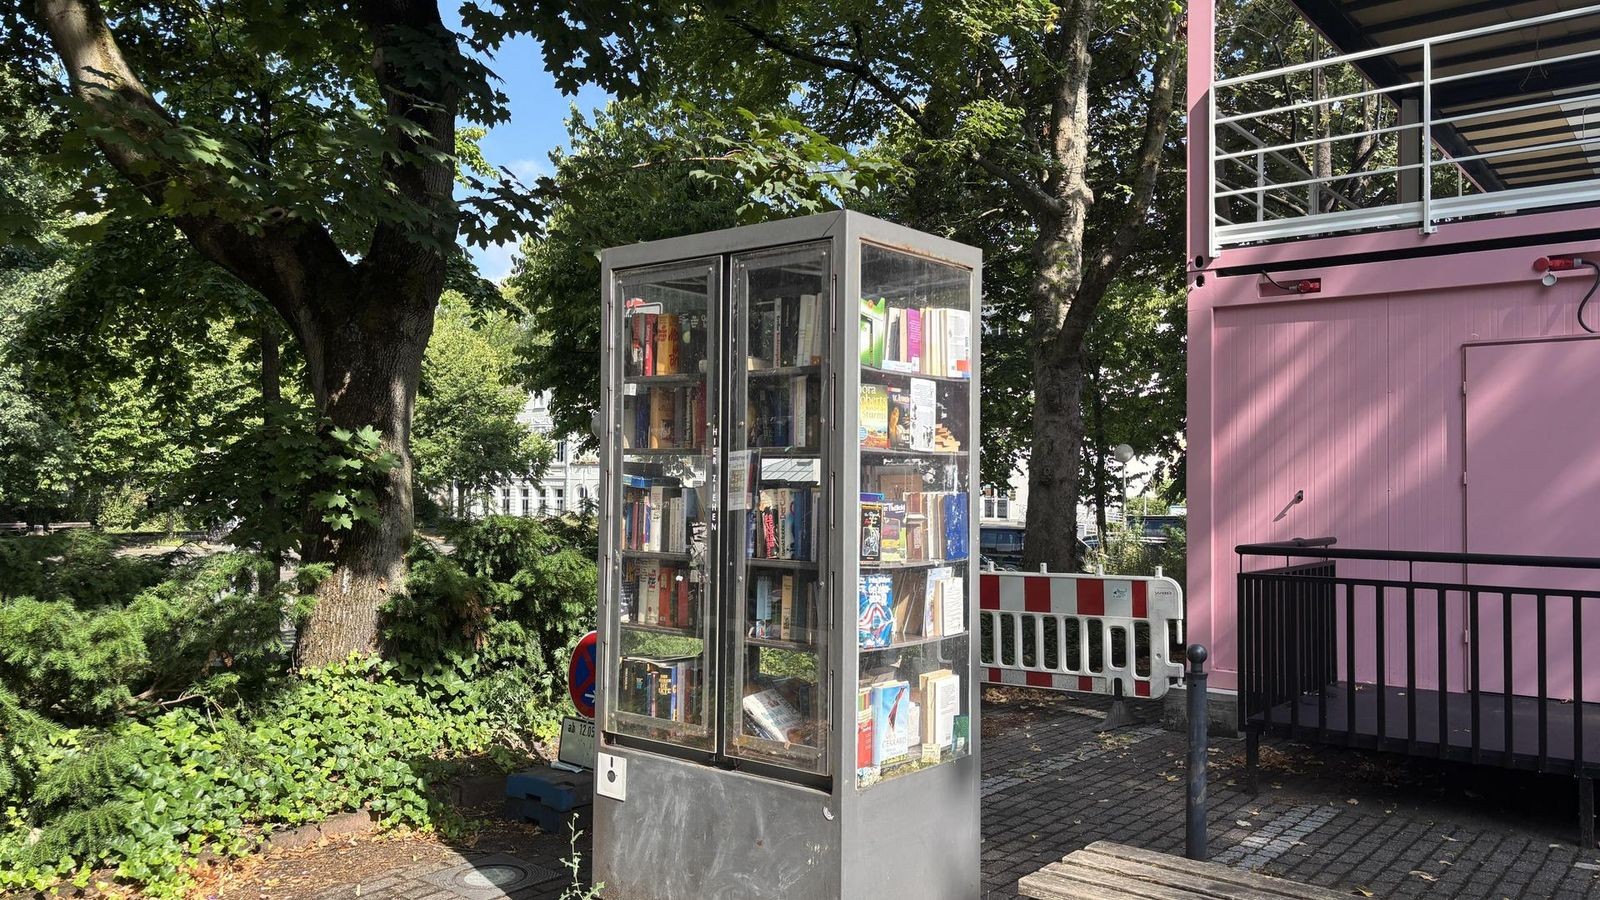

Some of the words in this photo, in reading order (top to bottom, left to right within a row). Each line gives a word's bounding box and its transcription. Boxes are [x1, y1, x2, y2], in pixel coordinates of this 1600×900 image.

[860, 385, 876, 395] ora
[860, 394, 887, 405] oberts
[567, 722, 576, 734] ab
